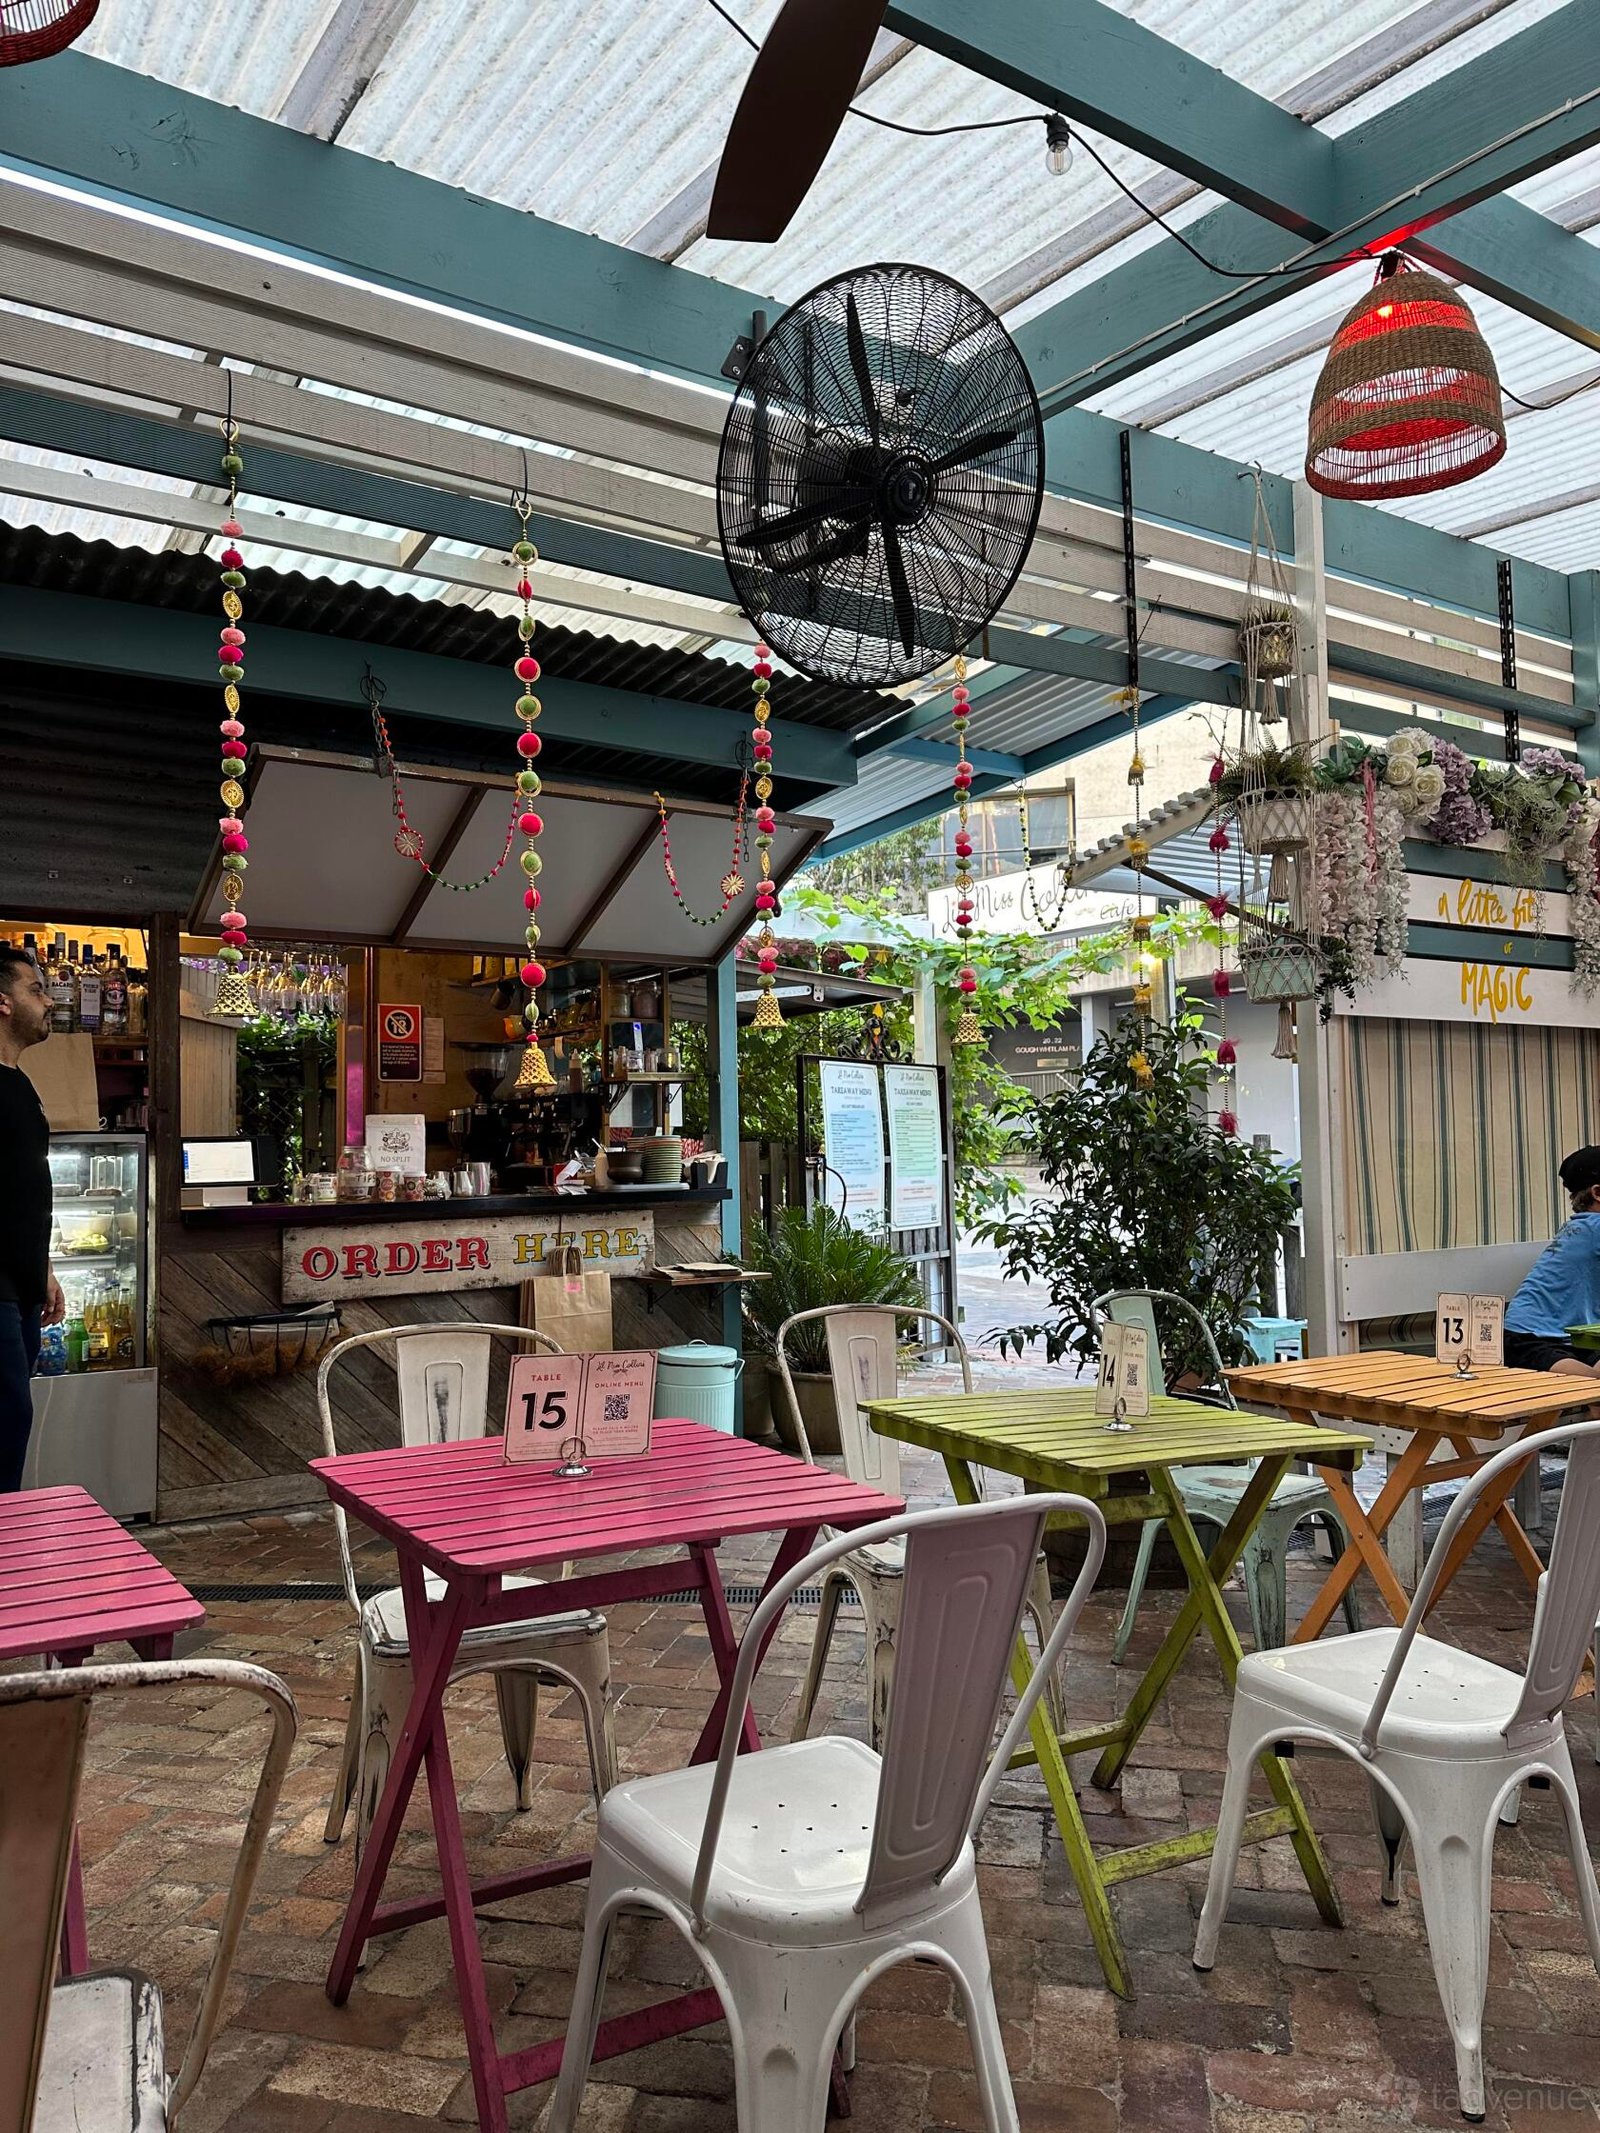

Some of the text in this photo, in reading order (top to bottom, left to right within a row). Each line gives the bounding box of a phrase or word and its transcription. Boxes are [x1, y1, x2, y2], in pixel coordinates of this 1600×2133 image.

[974, 884, 1014, 922] Miss
[1457, 878, 1508, 925] little
[1503, 941, 1514, 954] OF
[1461, 961, 1533, 1025] MAGIC
[391, 1020, 407, 1034] 18
[831, 1086, 858, 1095] TAKEAWAY
[894, 1088, 919, 1096] TAKEAWAY
[301, 1237, 491, 1281] ORDER
[1442, 1317, 1464, 1344] 13
[531, 1373, 562, 1382] TABLE
[1102, 1354, 1116, 1387] 14
[521, 1390, 568, 1432] 15
